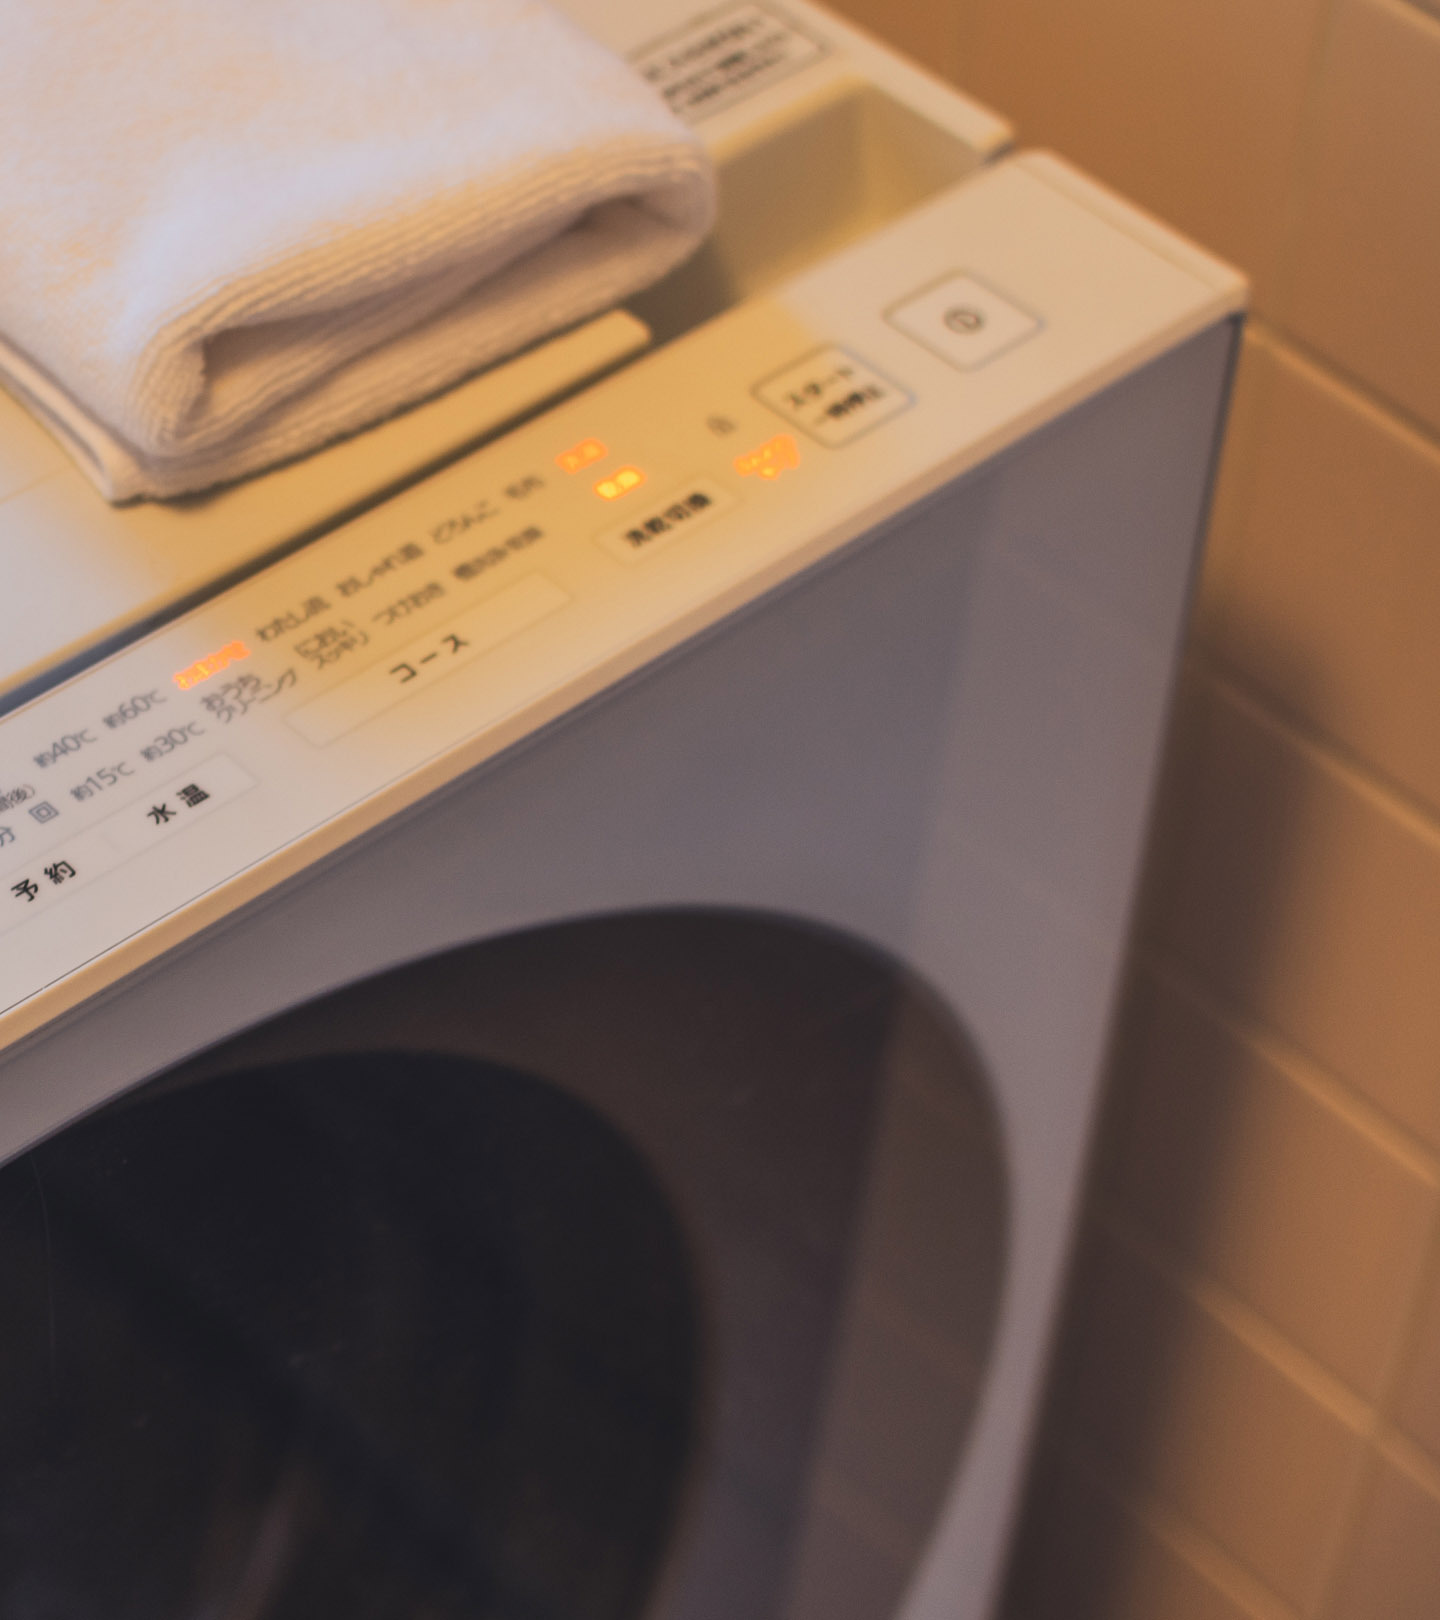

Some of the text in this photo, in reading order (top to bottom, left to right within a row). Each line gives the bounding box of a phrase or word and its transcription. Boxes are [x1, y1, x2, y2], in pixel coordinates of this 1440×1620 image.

[389, 633, 469, 684] コース
[28, 801, 59, 824] 回
[147, 784, 210, 826] 水温
[11, 859, 77, 903] 予約
